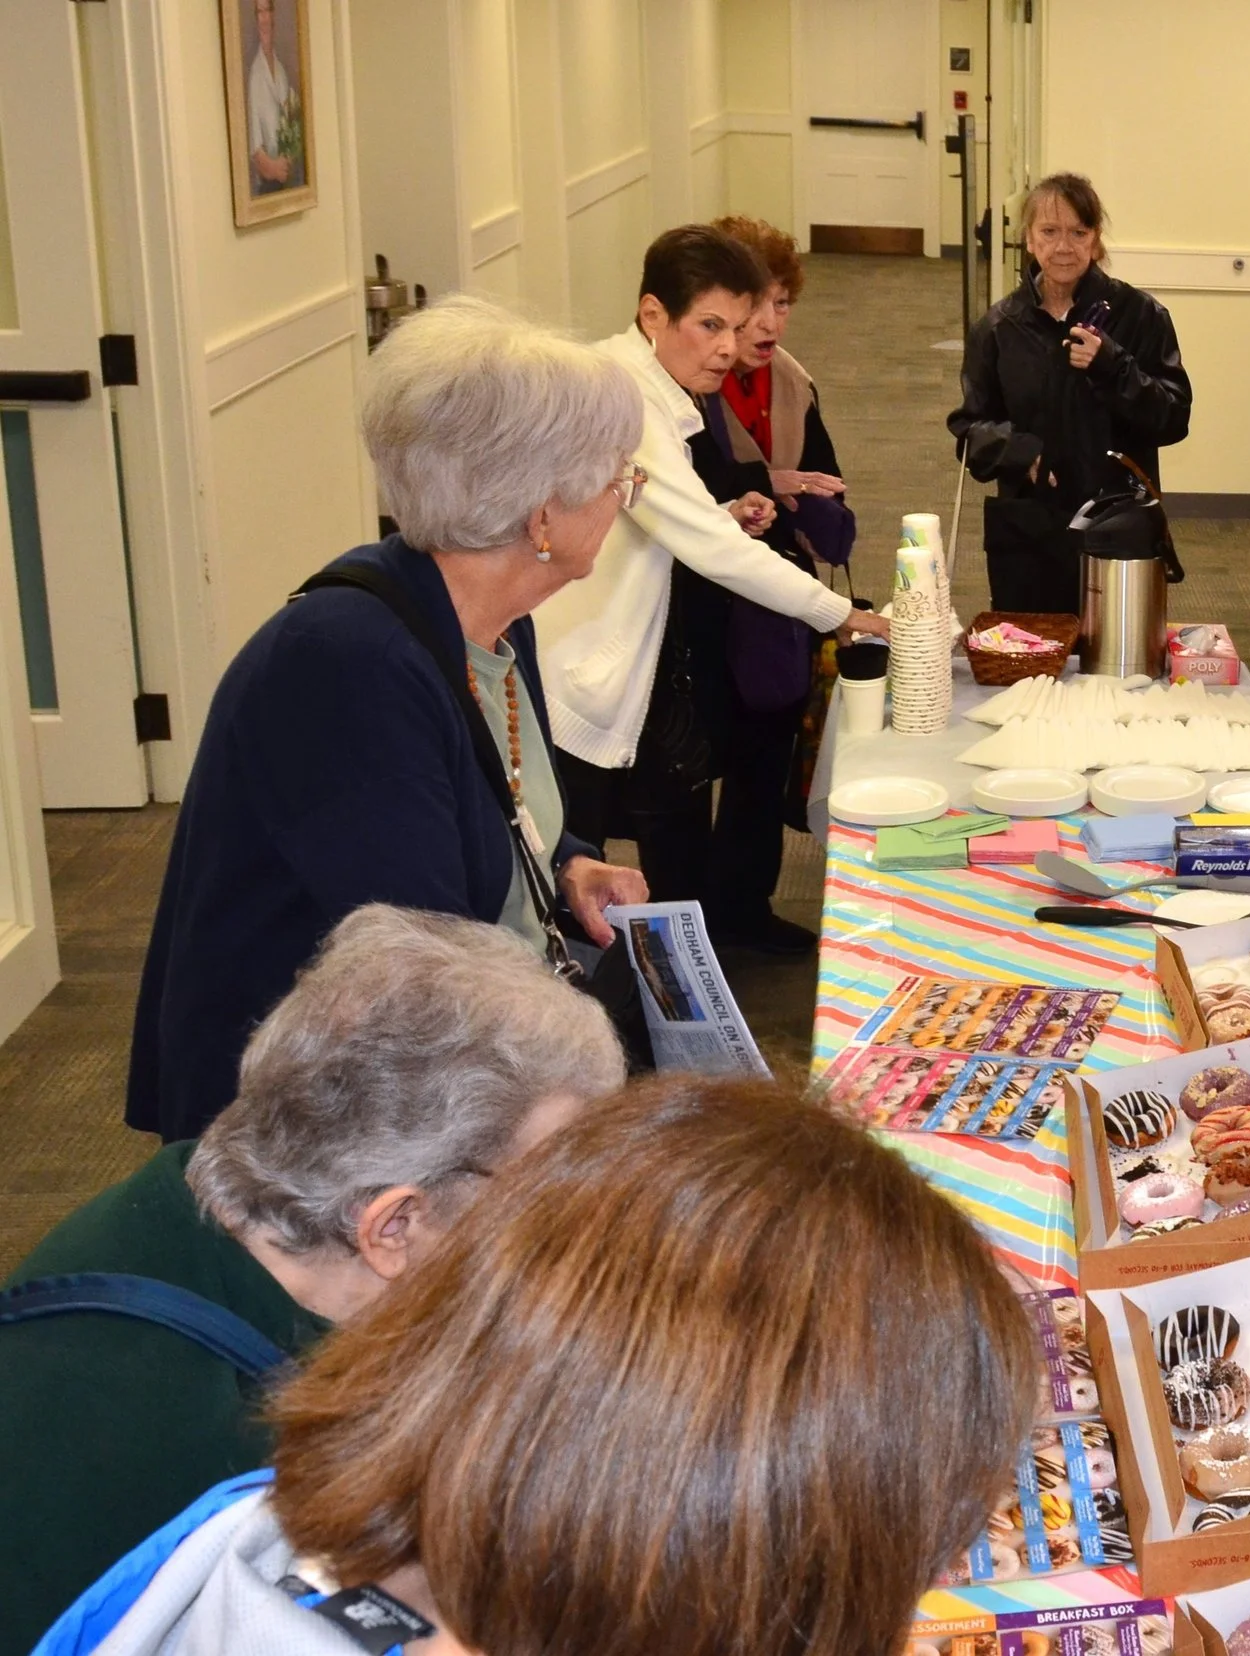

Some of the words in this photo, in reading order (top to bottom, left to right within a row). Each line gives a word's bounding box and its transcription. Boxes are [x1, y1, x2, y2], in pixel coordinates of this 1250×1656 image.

[1188, 662, 1221, 673] POLY
[1191, 859, 1246, 873] Reynolds
[680, 912, 706, 966] DEDHAM
[699, 970, 730, 1023] COUNCIL
[723, 1026, 740, 1042] ON
[734, 1045, 753, 1068] AGI
[1037, 1607, 1105, 1624] BREAKFAST
[1110, 1604, 1135, 1616] BOX
